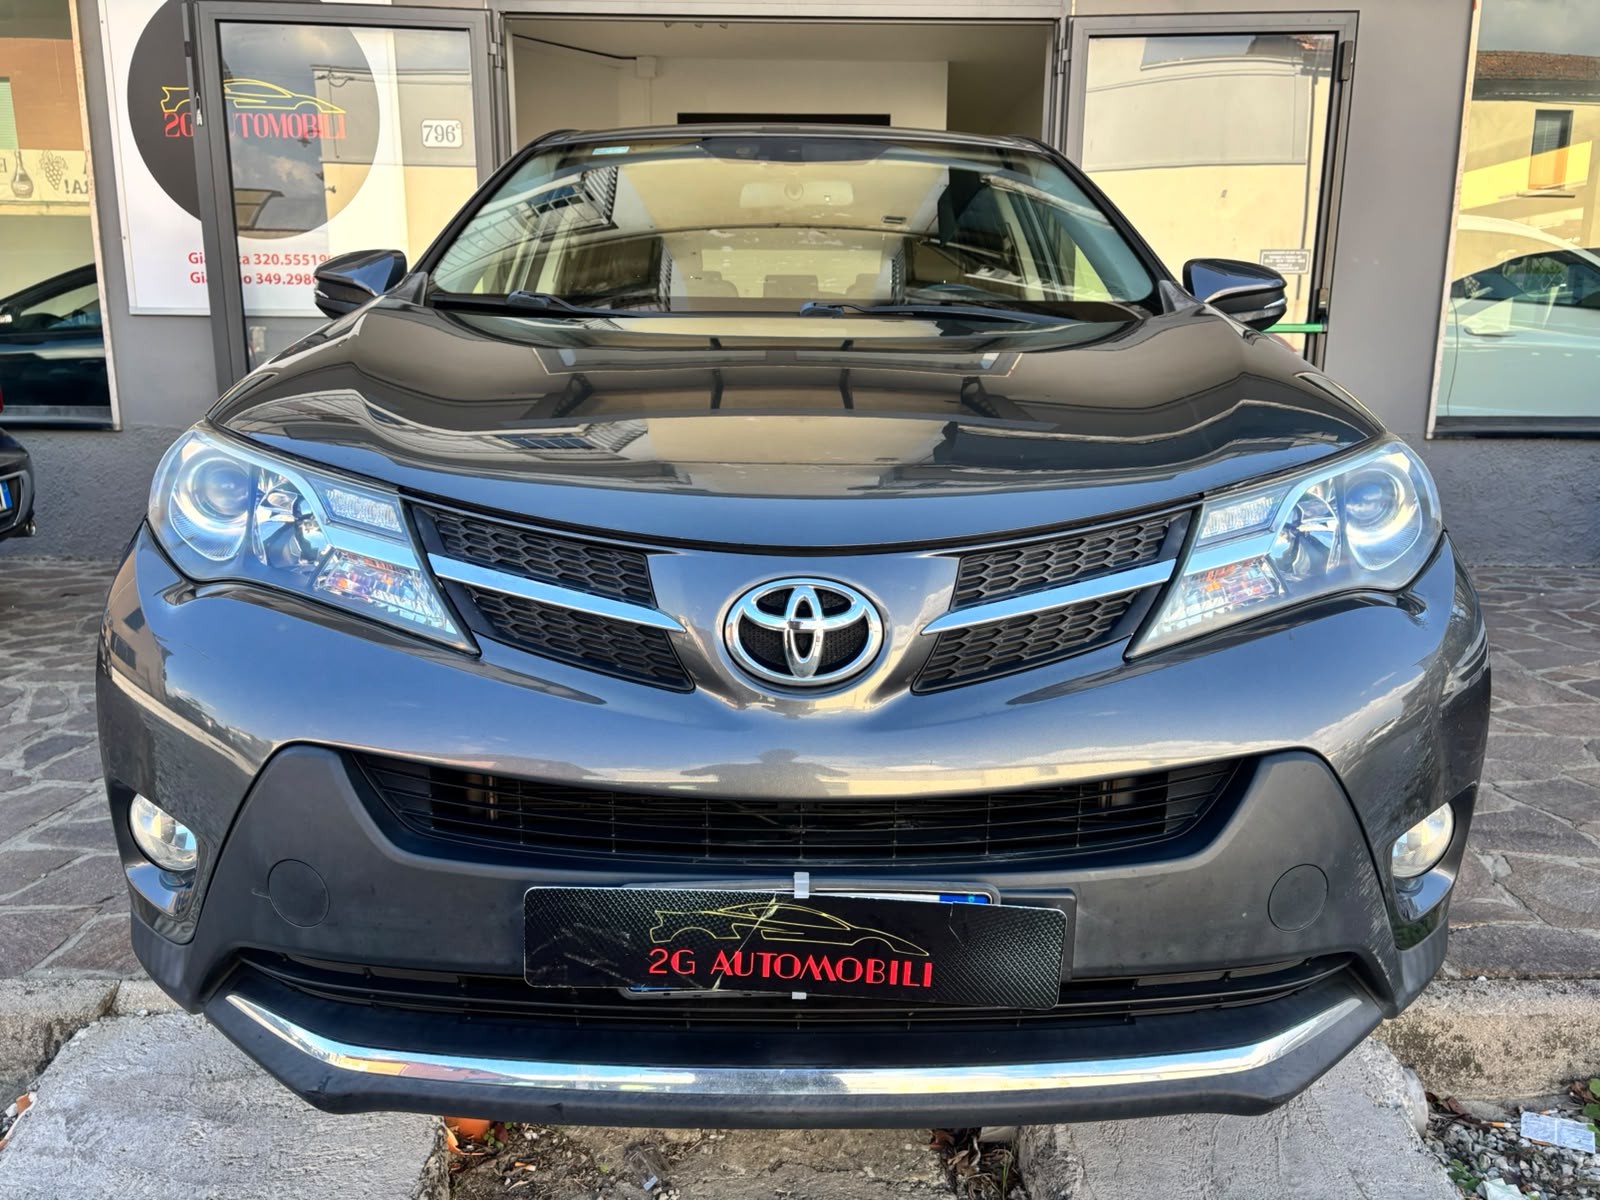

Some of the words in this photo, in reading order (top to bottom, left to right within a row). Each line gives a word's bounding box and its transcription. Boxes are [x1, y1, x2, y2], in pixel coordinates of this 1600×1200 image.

[163, 112, 194, 137] 2G
[229, 111, 346, 139] TOMOBILI
[649, 948, 696, 975] 2G
[710, 949, 933, 988] AUTOMOBILI
